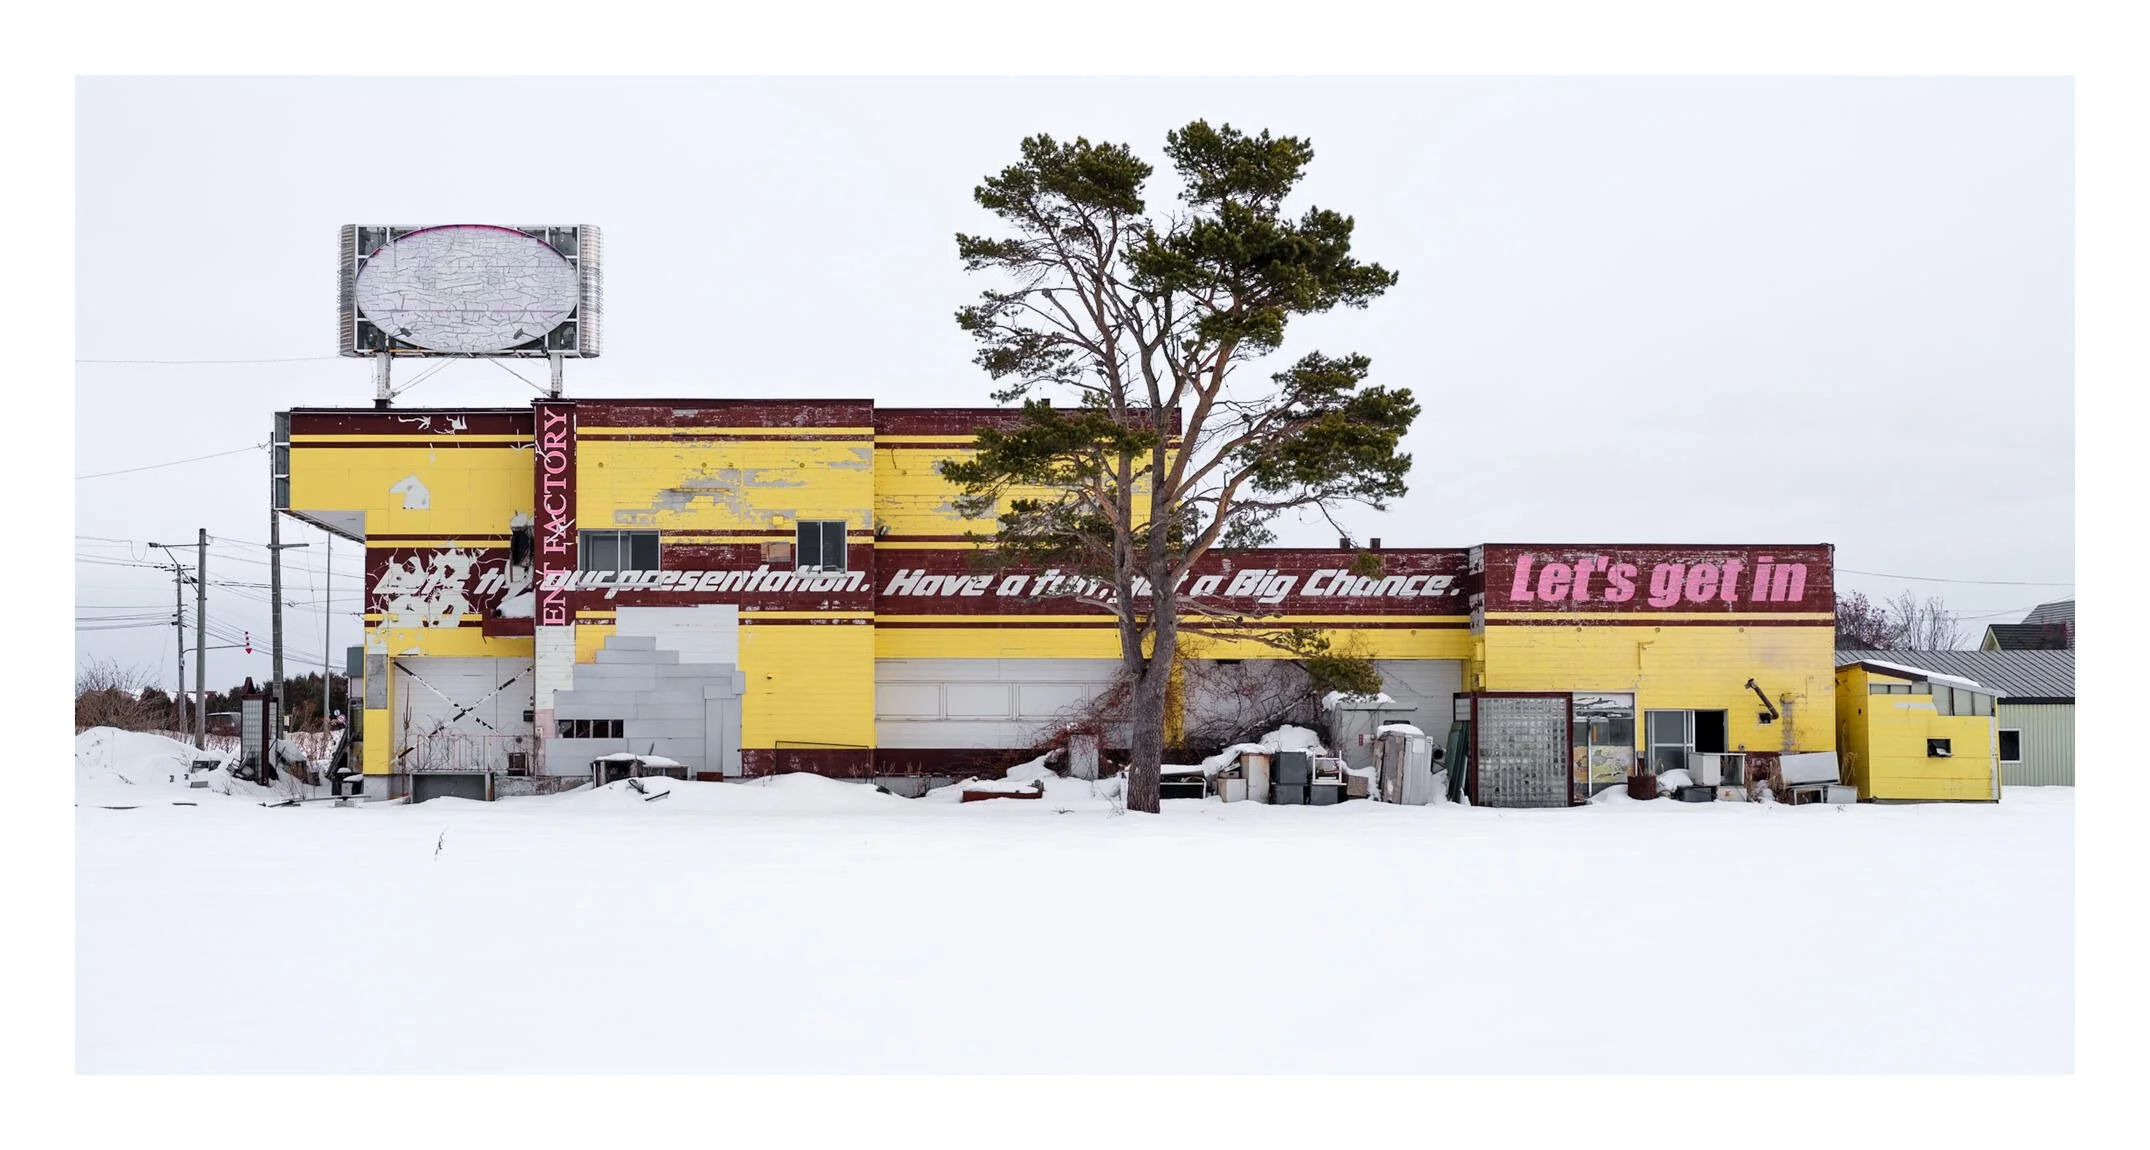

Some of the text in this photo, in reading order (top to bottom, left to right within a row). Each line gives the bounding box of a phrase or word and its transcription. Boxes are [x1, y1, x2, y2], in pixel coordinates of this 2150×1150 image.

[543, 406, 567, 555] FACTORY
[540, 570, 615, 591] our
[604, 564, 870, 599] presentation.
[883, 569, 993, 596] Have
[996, 575, 1030, 596] a
[1189, 575, 1223, 597] a
[1225, 569, 1299, 604] Big
[1301, 569, 1460, 596] Chance.
[1510, 555, 1808, 608] Let's get in
